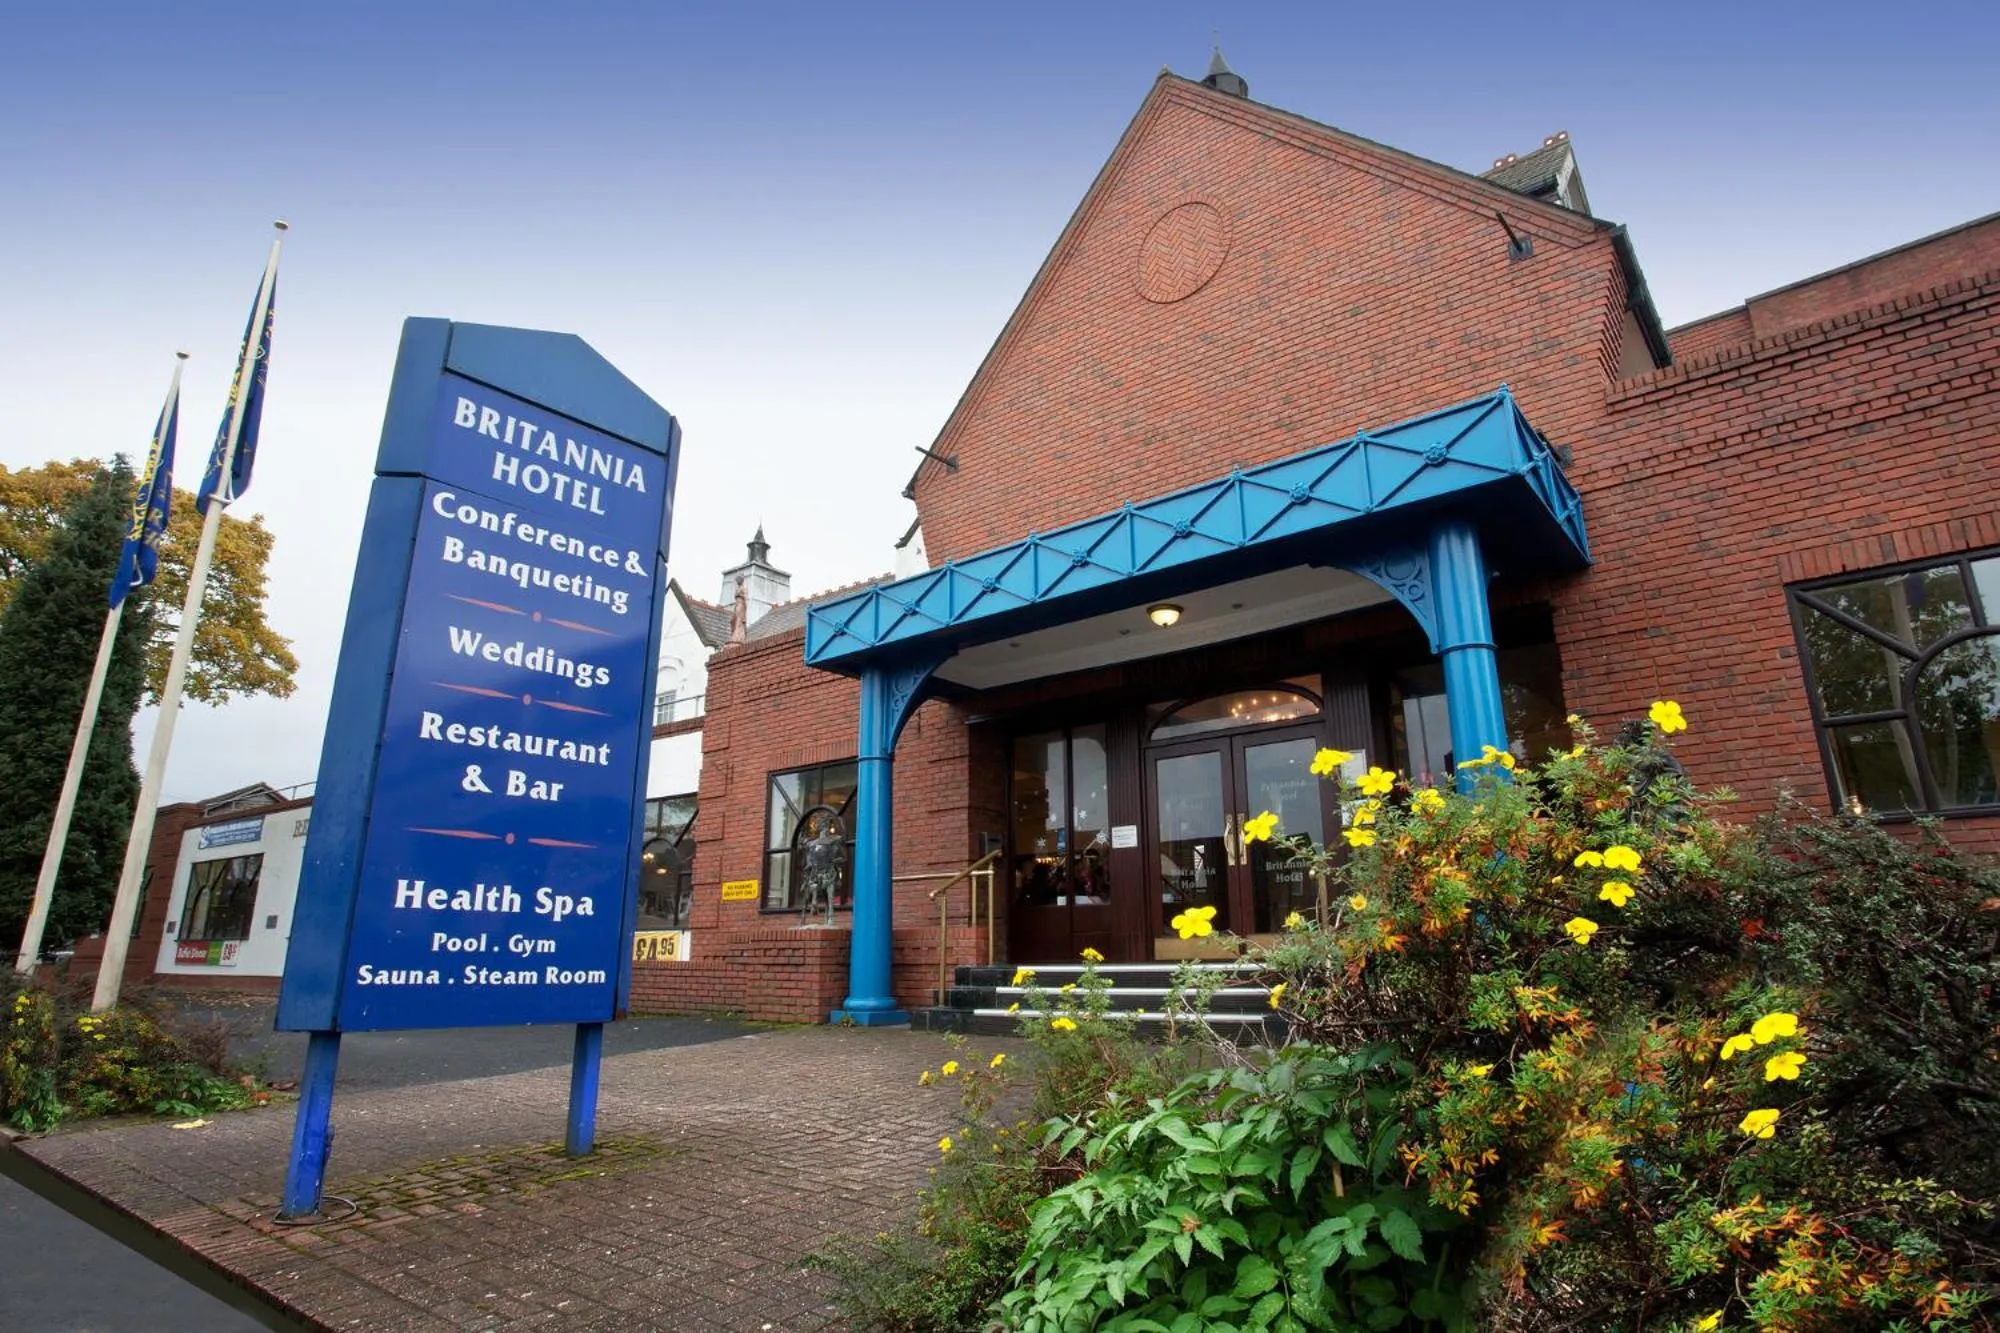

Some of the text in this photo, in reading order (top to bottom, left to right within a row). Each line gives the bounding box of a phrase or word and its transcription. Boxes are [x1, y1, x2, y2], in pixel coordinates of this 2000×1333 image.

[453, 396, 647, 494] BRITANNIA
[492, 451, 606, 516] HOTEL
[432, 491, 649, 577] Conference &
[442, 535, 629, 615] Banqueting
[448, 625, 611, 688] Weddings
[418, 711, 611, 766] Restaurant
[461, 764, 565, 801] & Bar
[394, 879, 594, 922] Health Spa
[357, 964, 440, 985] Sauna
[463, 965, 538, 985] Steam
[545, 966, 606, 985] Room
[432, 932, 487, 953] Pool
[508, 934, 556, 958] Gym
